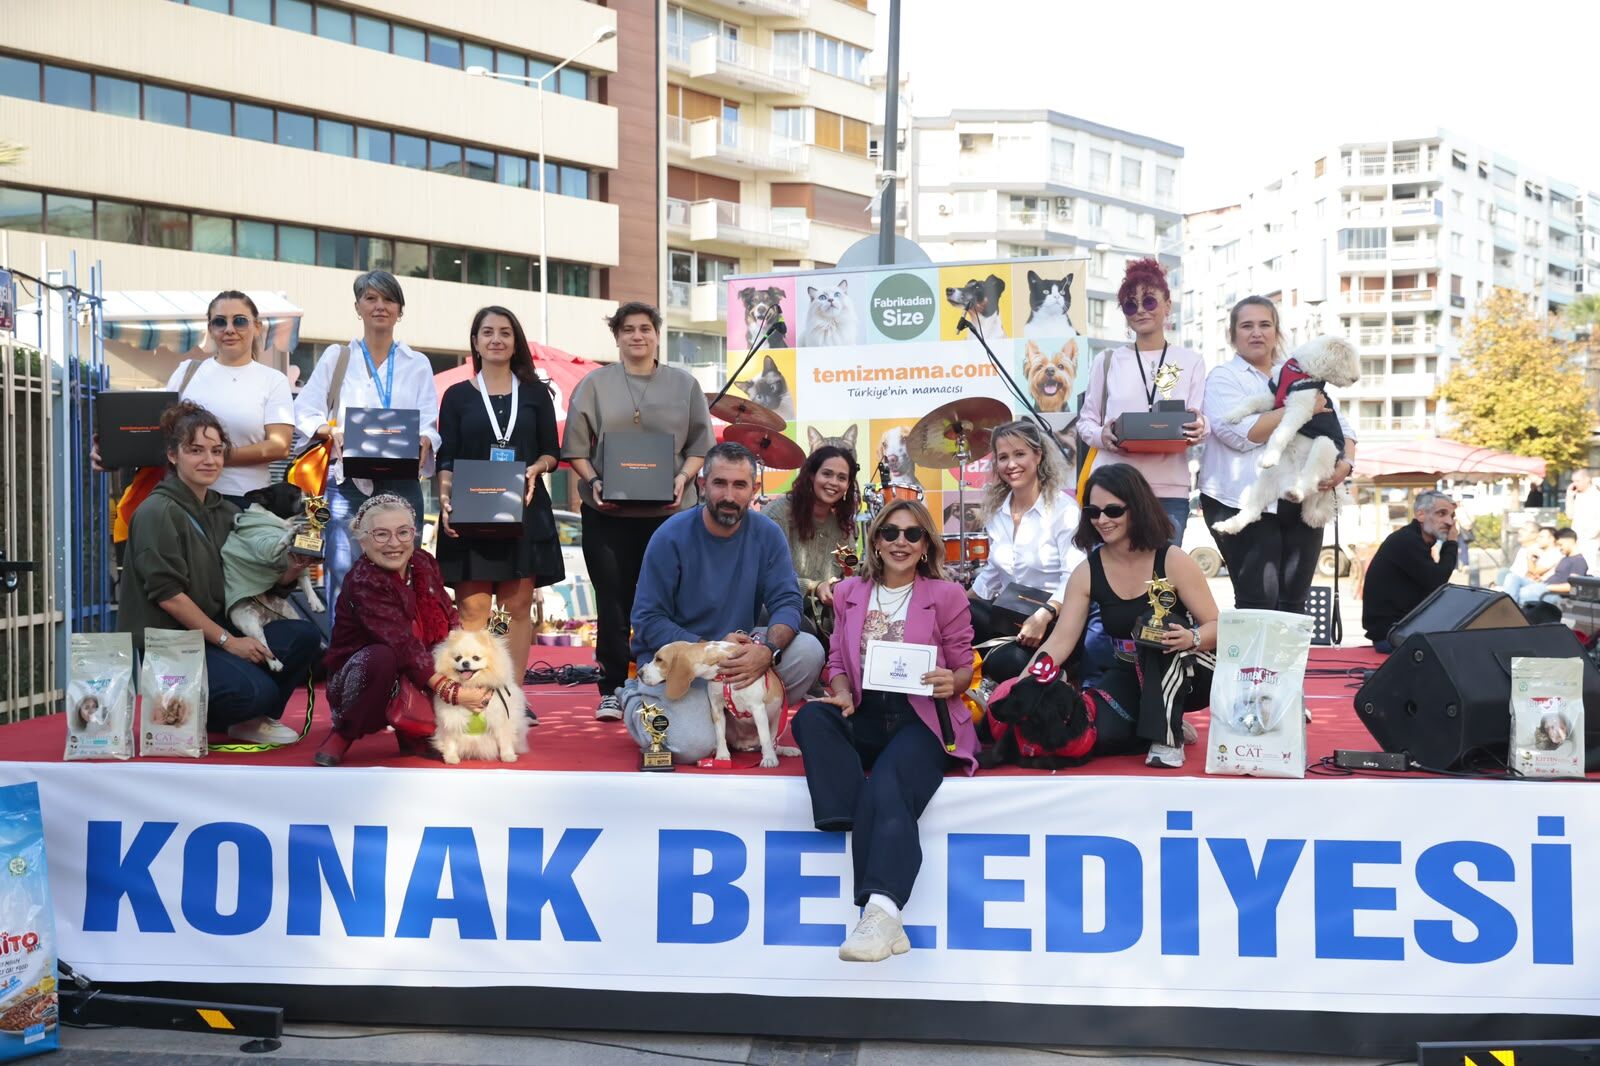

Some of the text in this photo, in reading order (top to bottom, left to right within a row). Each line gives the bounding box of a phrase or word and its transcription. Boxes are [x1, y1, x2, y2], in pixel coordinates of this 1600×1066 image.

[874, 296, 932, 308] Fabrikadan
[882, 309, 924, 327] Size
[812, 362, 998, 383] temizmama.com
[848, 385, 963, 399] Türkiye'nin mamacısı
[1235, 745, 1263, 758] CAT
[82, 820, 602, 943] KONAK
